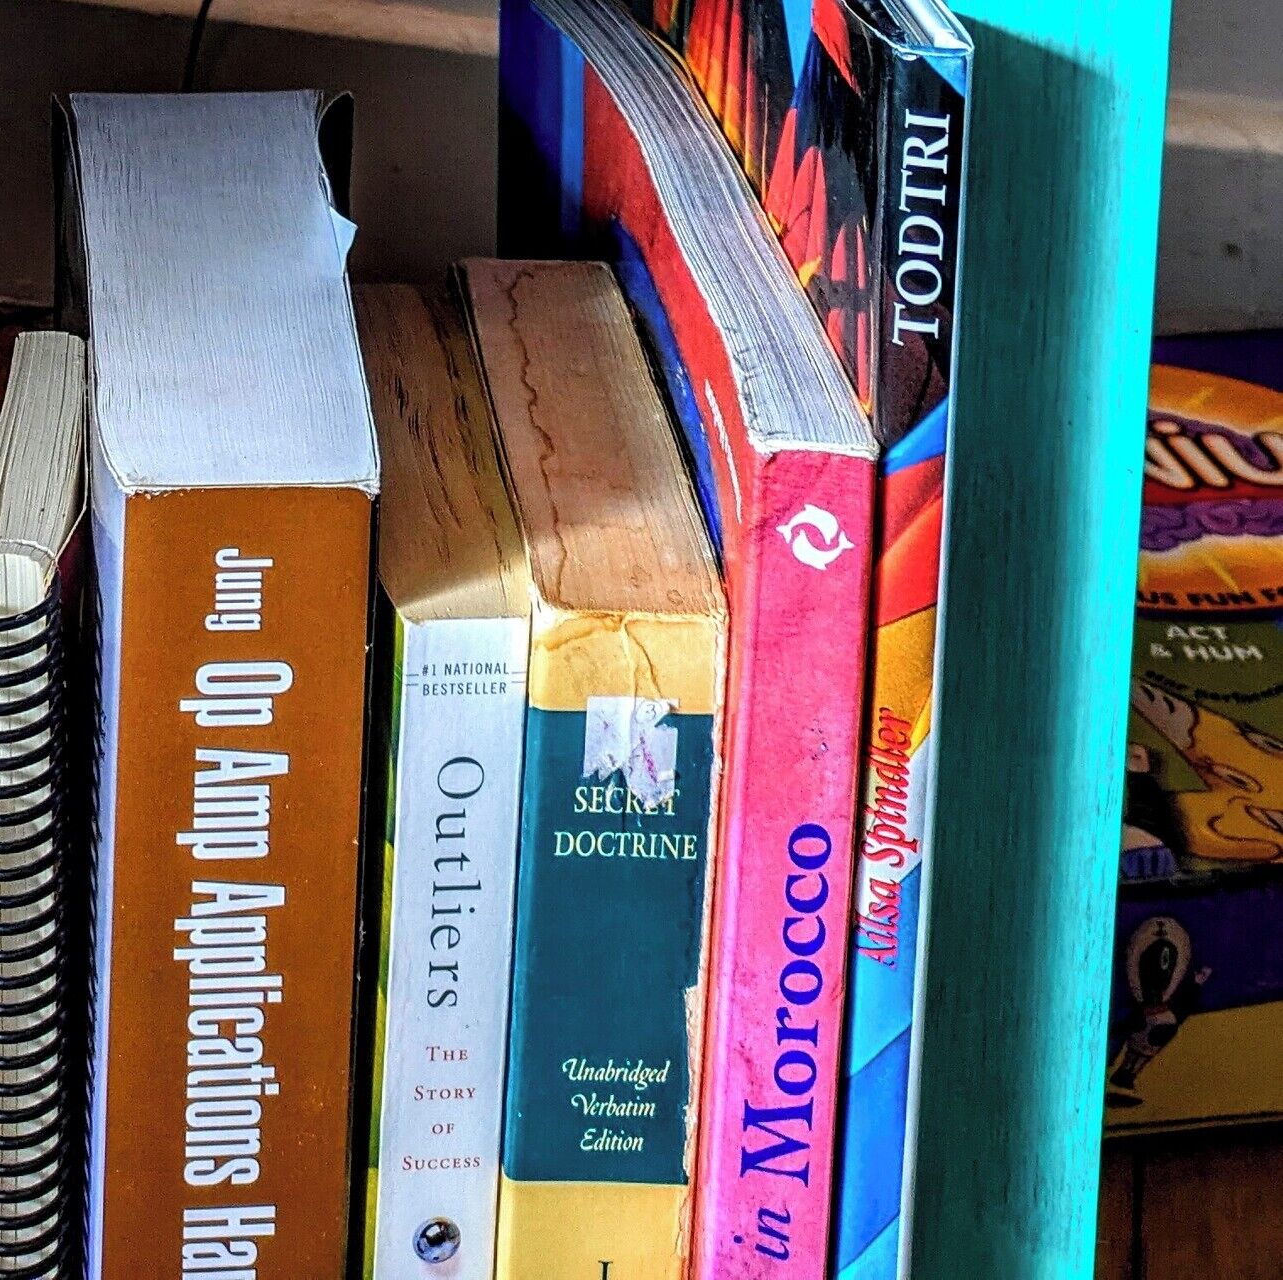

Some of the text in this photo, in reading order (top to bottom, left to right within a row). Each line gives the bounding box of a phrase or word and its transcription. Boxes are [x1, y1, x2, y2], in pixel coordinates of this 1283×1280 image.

[892, 110, 951, 347] TODTRI
[205, 547, 272, 632] Jung
[1167, 624, 1227, 640] ACT
[1183, 644, 1263, 661] HUM
[178, 659, 294, 728] Op
[422, 662, 509, 676] #1 NATIONAL
[422, 682, 507, 696] BESTSELLER
[174, 749, 290, 861] Amp
[554, 831, 697, 860] DOCTRINE
[856, 706, 918, 970] Ailsa Spindler
[428, 755, 485, 1010] Outliers
[174, 881, 287, 1187] Applications
[733, 822, 832, 1261] in Morocco
[562, 1058, 670, 1090] Unabridged
[571, 1093, 656, 1117] Verbatim
[580, 1128, 644, 1151] Edition
